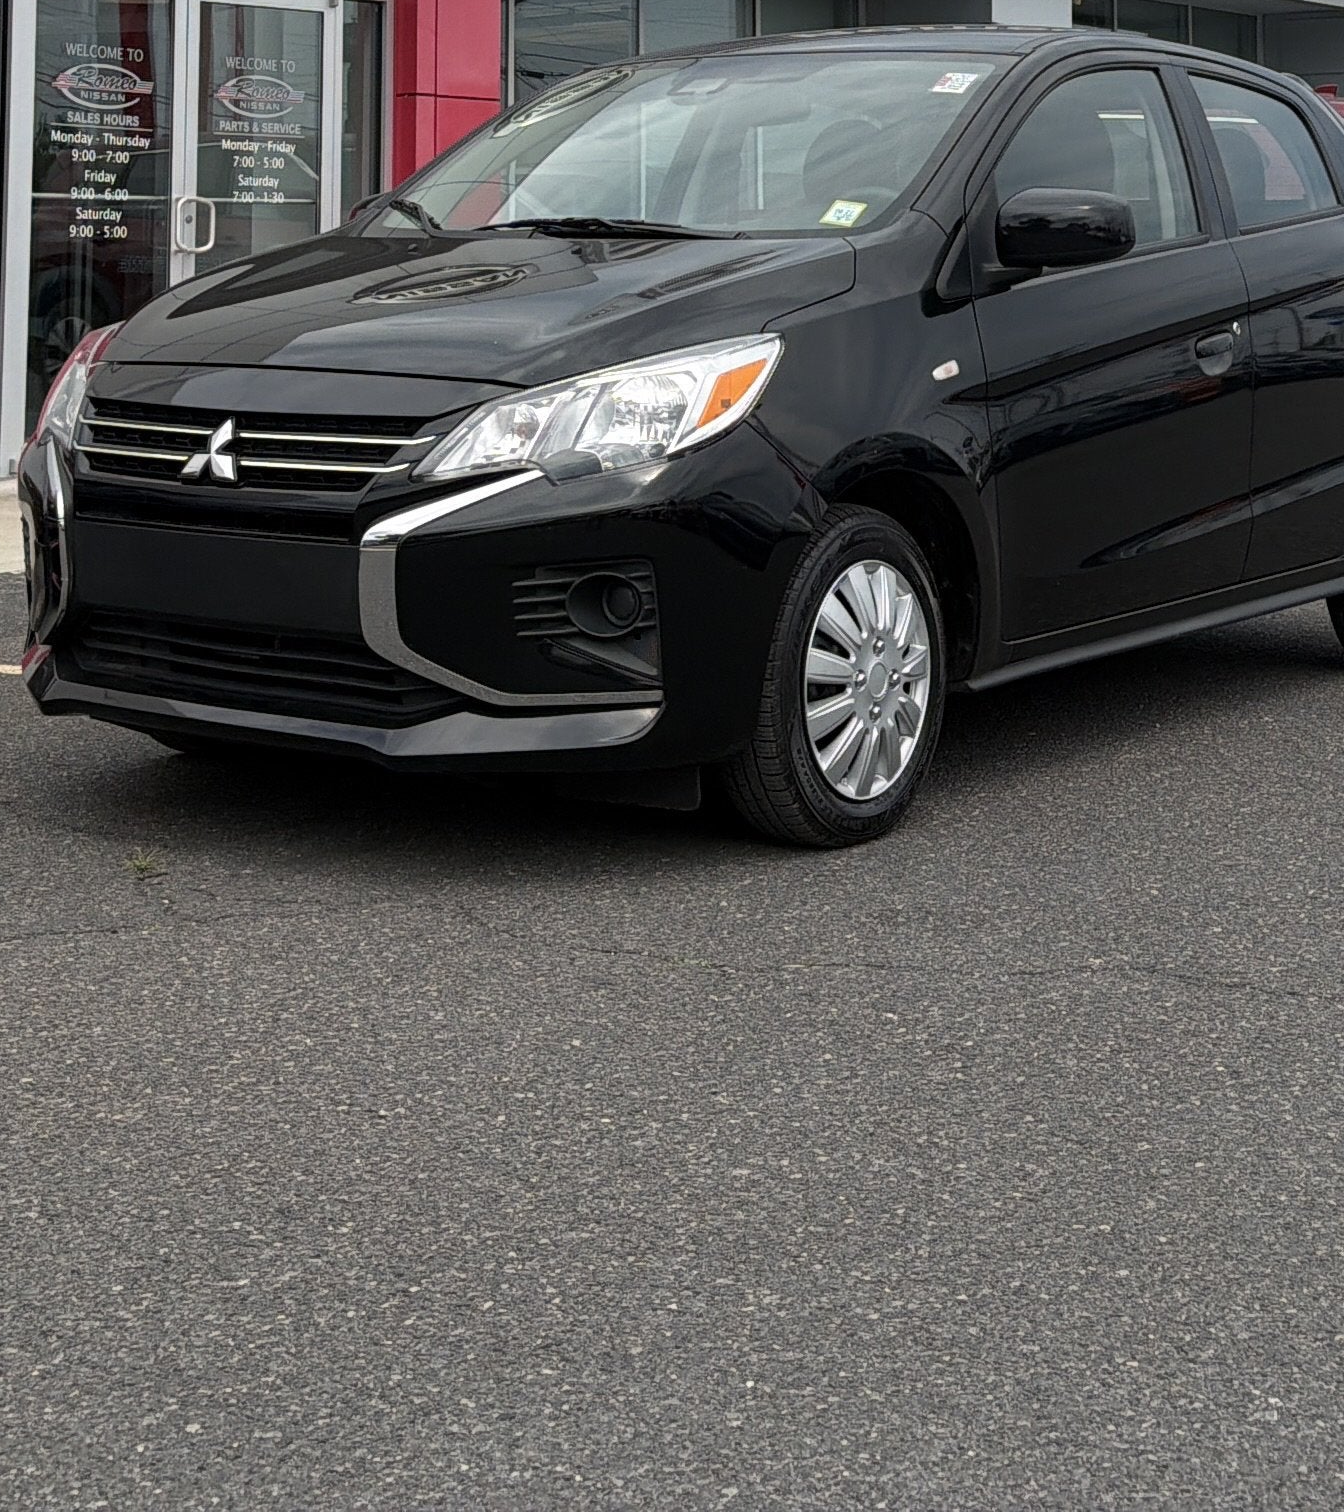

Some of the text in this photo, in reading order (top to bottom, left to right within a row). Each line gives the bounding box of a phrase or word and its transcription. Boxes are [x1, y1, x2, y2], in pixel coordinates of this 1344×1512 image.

[65, 42, 144, 63] WELCOME TO
[225, 56, 296, 73] WELCOME TO
[72, 65, 137, 90] Romeo
[80, 90, 126, 102] NISSAN
[235, 77, 290, 101] Romeo
[239, 101, 280, 111] NISSAN
[67, 110, 140, 127] SALES HOURS
[219, 120, 302, 135] PARTS & SERVICE
[50, 130, 94, 146] Monday
[102, 132, 151, 150] Thursday
[221, 138, 259, 153] Monday
[267, 140, 297, 156] Friday
[71, 148, 96, 162] 9:00
[105, 150, 130, 164] 7:00
[232, 156, 255, 168] 7:00
[263, 157, 285, 169] 5:00
[84, 169, 117, 185] Friday
[237, 174, 280, 189] Saturday
[70, 187, 95, 200] 9:00
[104, 188, 129, 201] 6:00
[232, 191, 255, 203] 7:00
[263, 192, 285, 204] 1:30
[75, 206, 123, 223] Saturday
[69, 224, 94, 238] 9:00
[103, 225, 128, 239] 5:00
